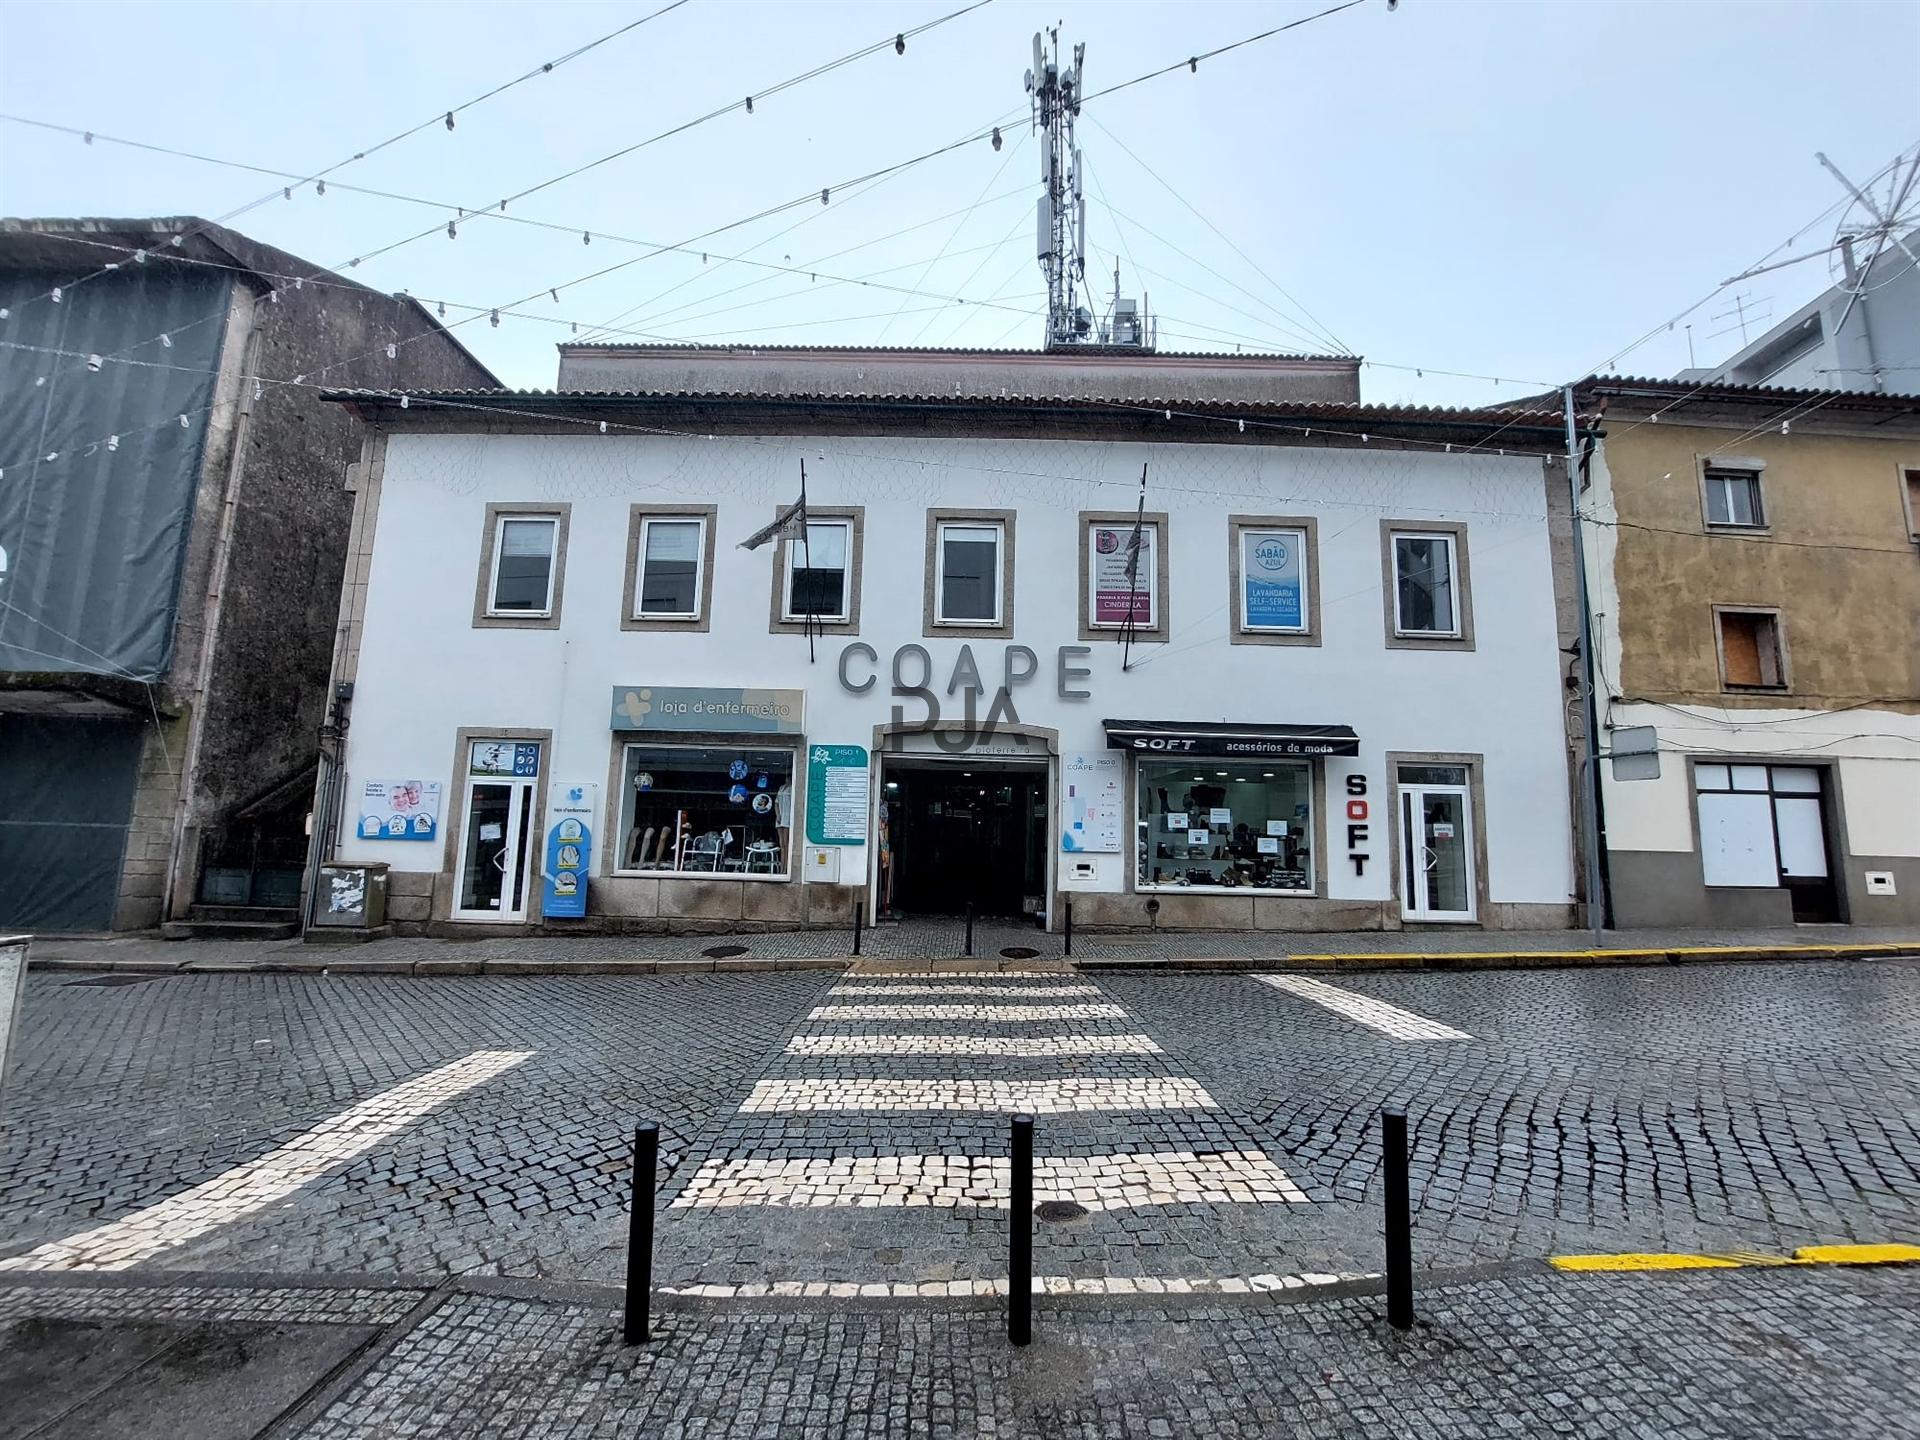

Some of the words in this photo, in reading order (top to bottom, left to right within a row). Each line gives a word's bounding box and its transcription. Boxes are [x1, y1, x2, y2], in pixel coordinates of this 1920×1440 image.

[1255, 546, 1285, 559] SABÃO
[1252, 588, 1293, 597] LAVANDARIA
[1104, 601, 1142, 609] CINDERLA
[1249, 597, 1297, 606] SELF-SERVICE
[838, 642, 1092, 698] COAPE
[660, 700, 687, 716] loja
[693, 700, 790, 715] d'enfermeiro
[834, 748, 853, 756] PISO
[1133, 738, 1197, 750] SOFT
[1226, 741, 1282, 752] acessórios
[1287, 743, 1300, 753] de
[1304, 744, 1334, 753] moda
[1346, 774, 1370, 876] SOFT
